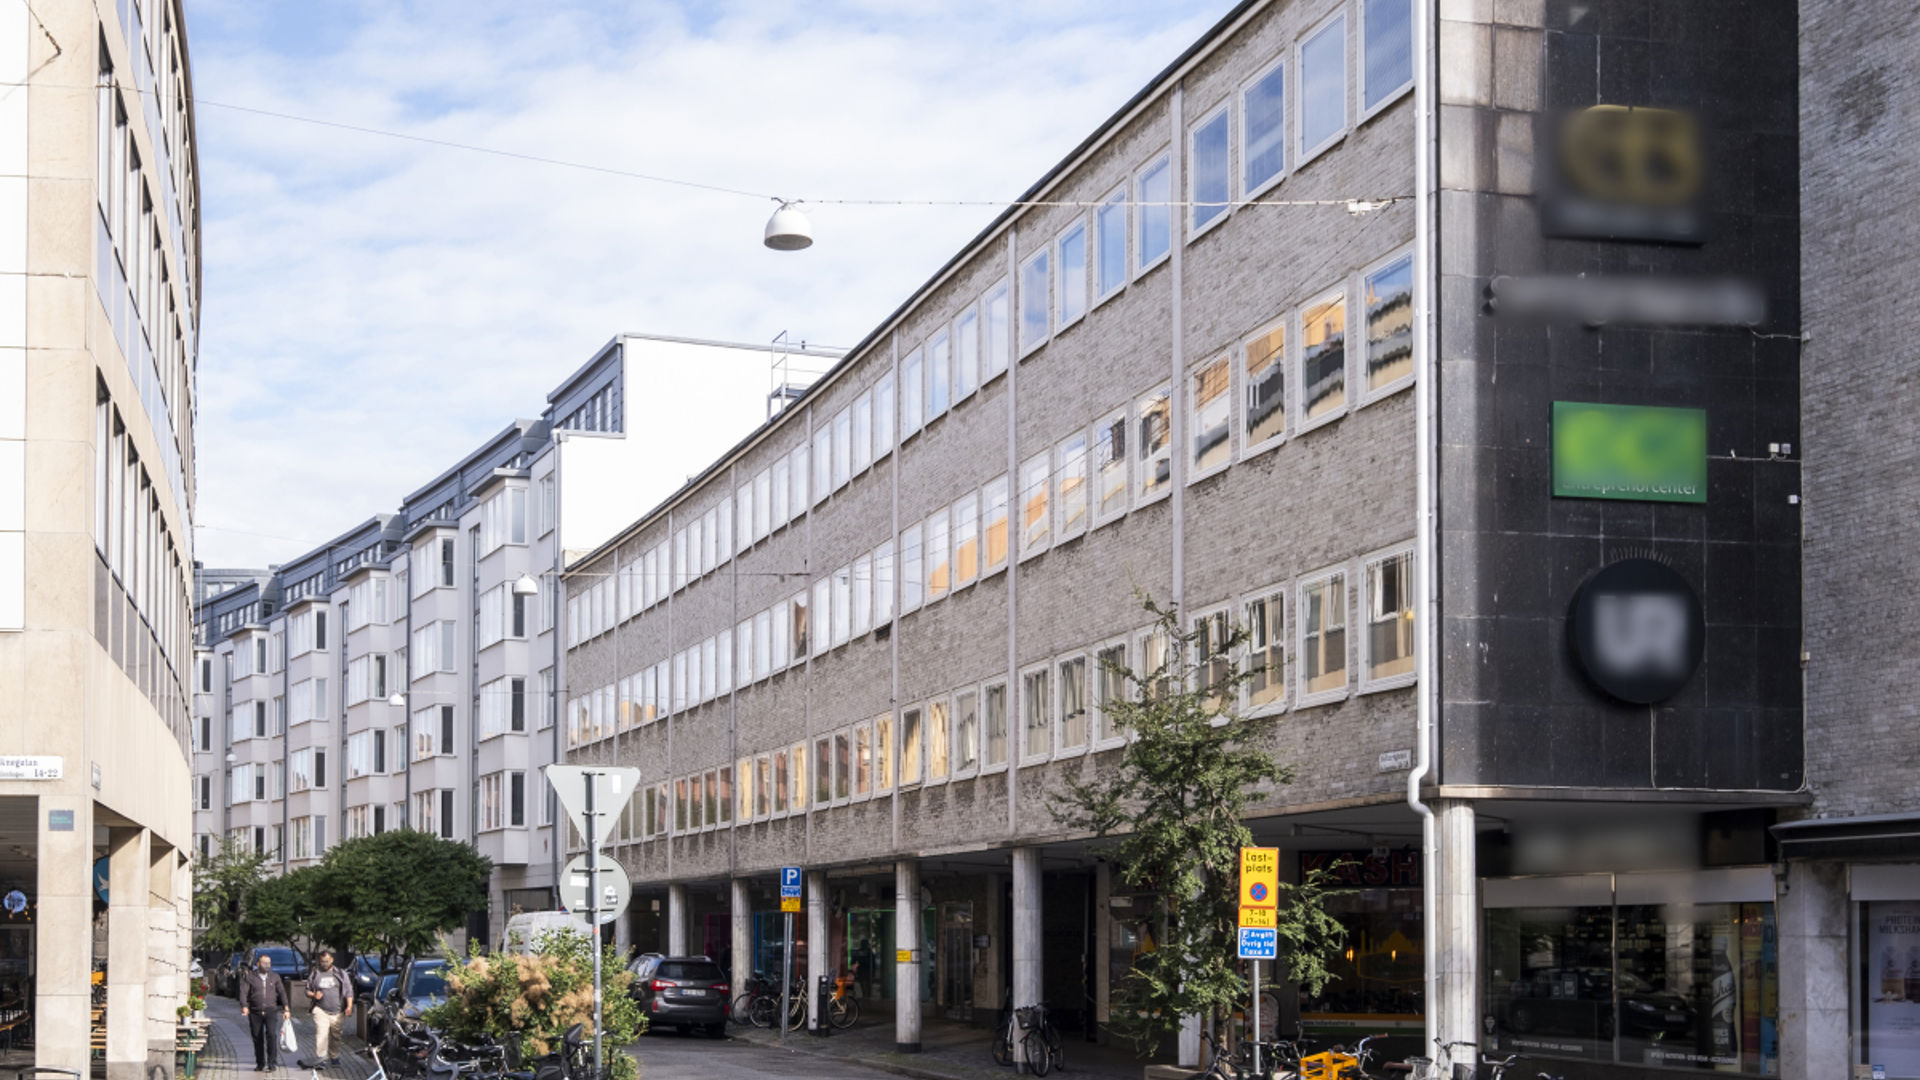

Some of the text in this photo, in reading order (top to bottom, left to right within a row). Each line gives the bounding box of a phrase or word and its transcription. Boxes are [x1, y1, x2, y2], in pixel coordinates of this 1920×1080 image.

[1246, 852, 1273, 862] Last-
[1246, 864, 1273, 874] plats
[786, 869, 798, 885] P
